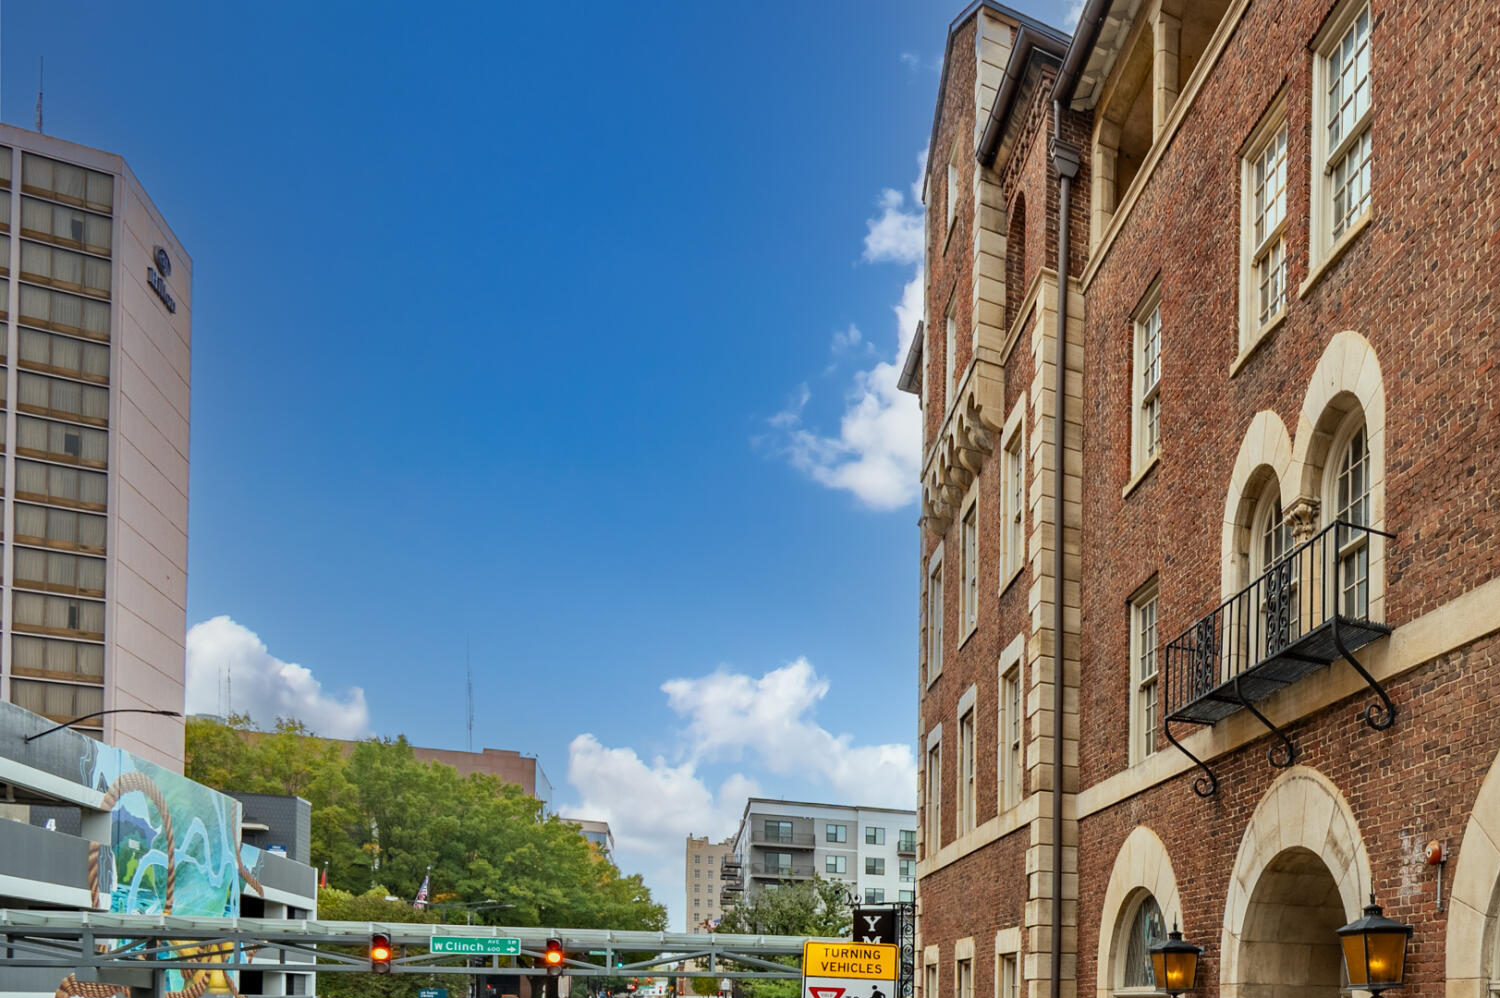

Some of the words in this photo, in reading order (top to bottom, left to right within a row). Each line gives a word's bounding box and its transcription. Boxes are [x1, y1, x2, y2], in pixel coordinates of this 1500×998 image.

[434, 943, 443, 951] W
[445, 941, 484, 951] Clinch
[824, 948, 881, 960] TURNING
[821, 961, 882, 974] VEHICLES
